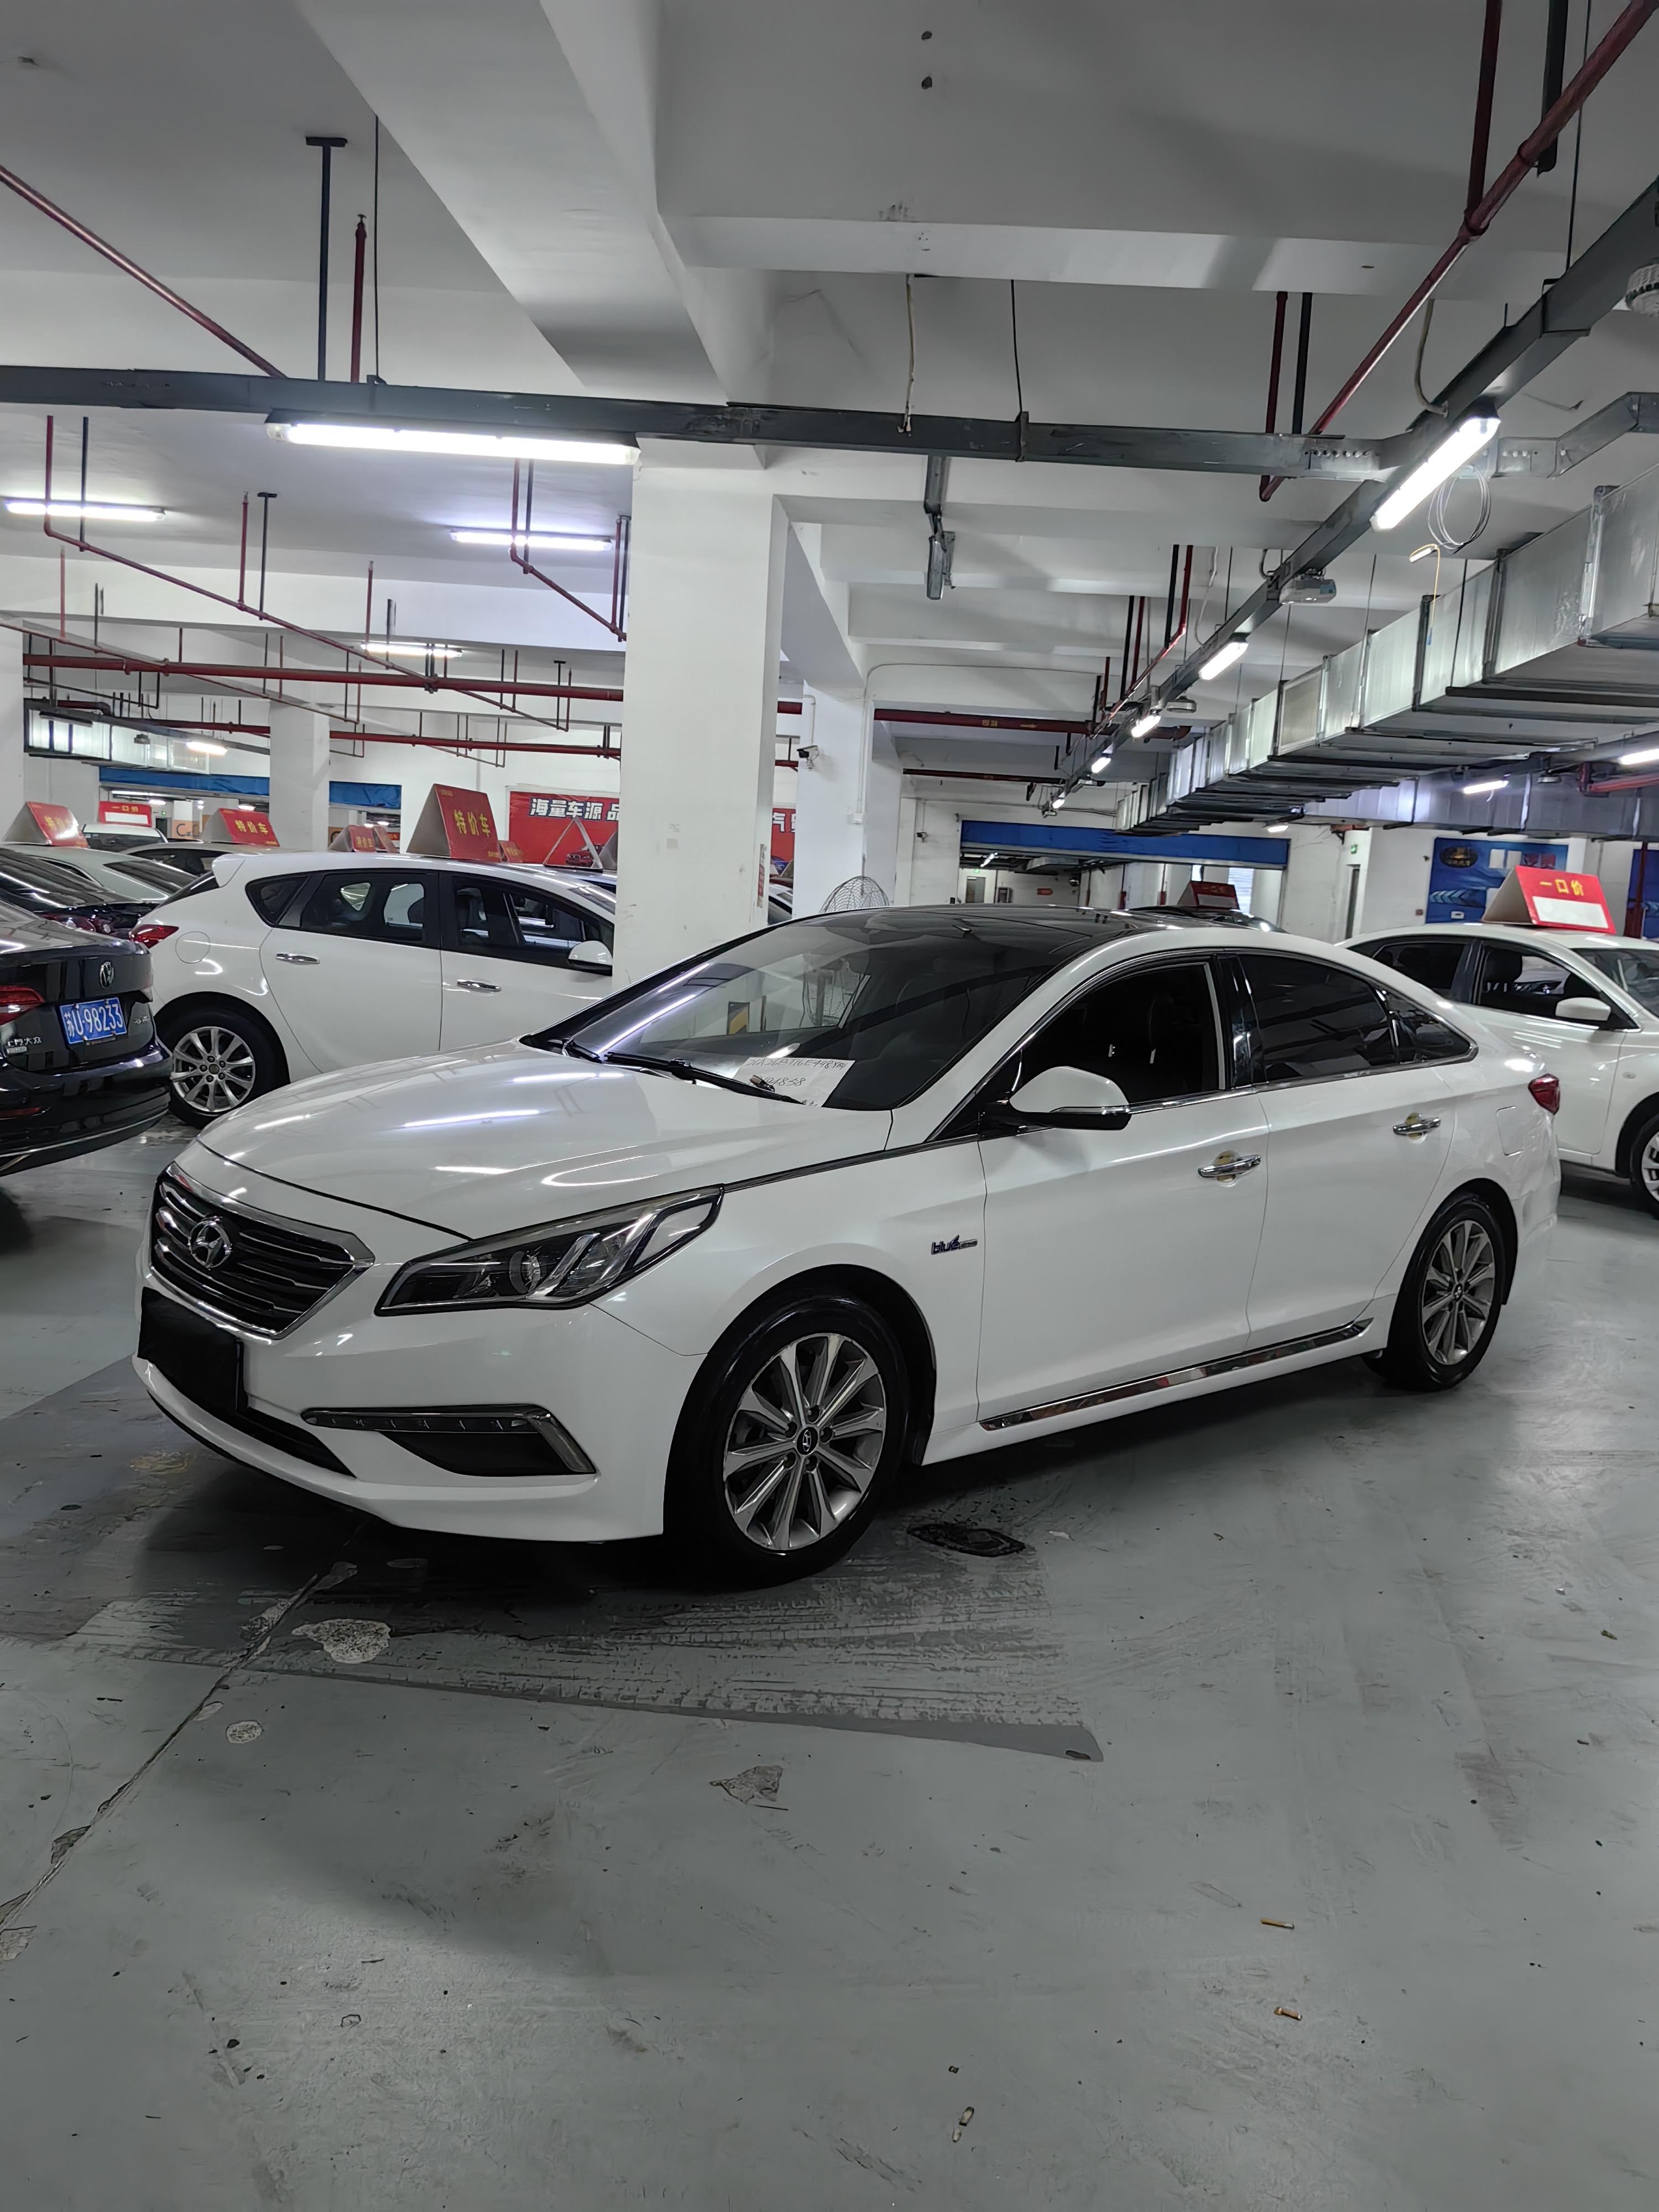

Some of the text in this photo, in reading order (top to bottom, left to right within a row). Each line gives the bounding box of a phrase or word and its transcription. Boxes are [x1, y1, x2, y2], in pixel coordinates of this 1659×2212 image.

[529, 798, 604, 821] 海量车源
[234, 820, 269, 834] 特价车
[453, 809, 491, 838] 特价车
[1540, 879, 1584, 896] 一口价
